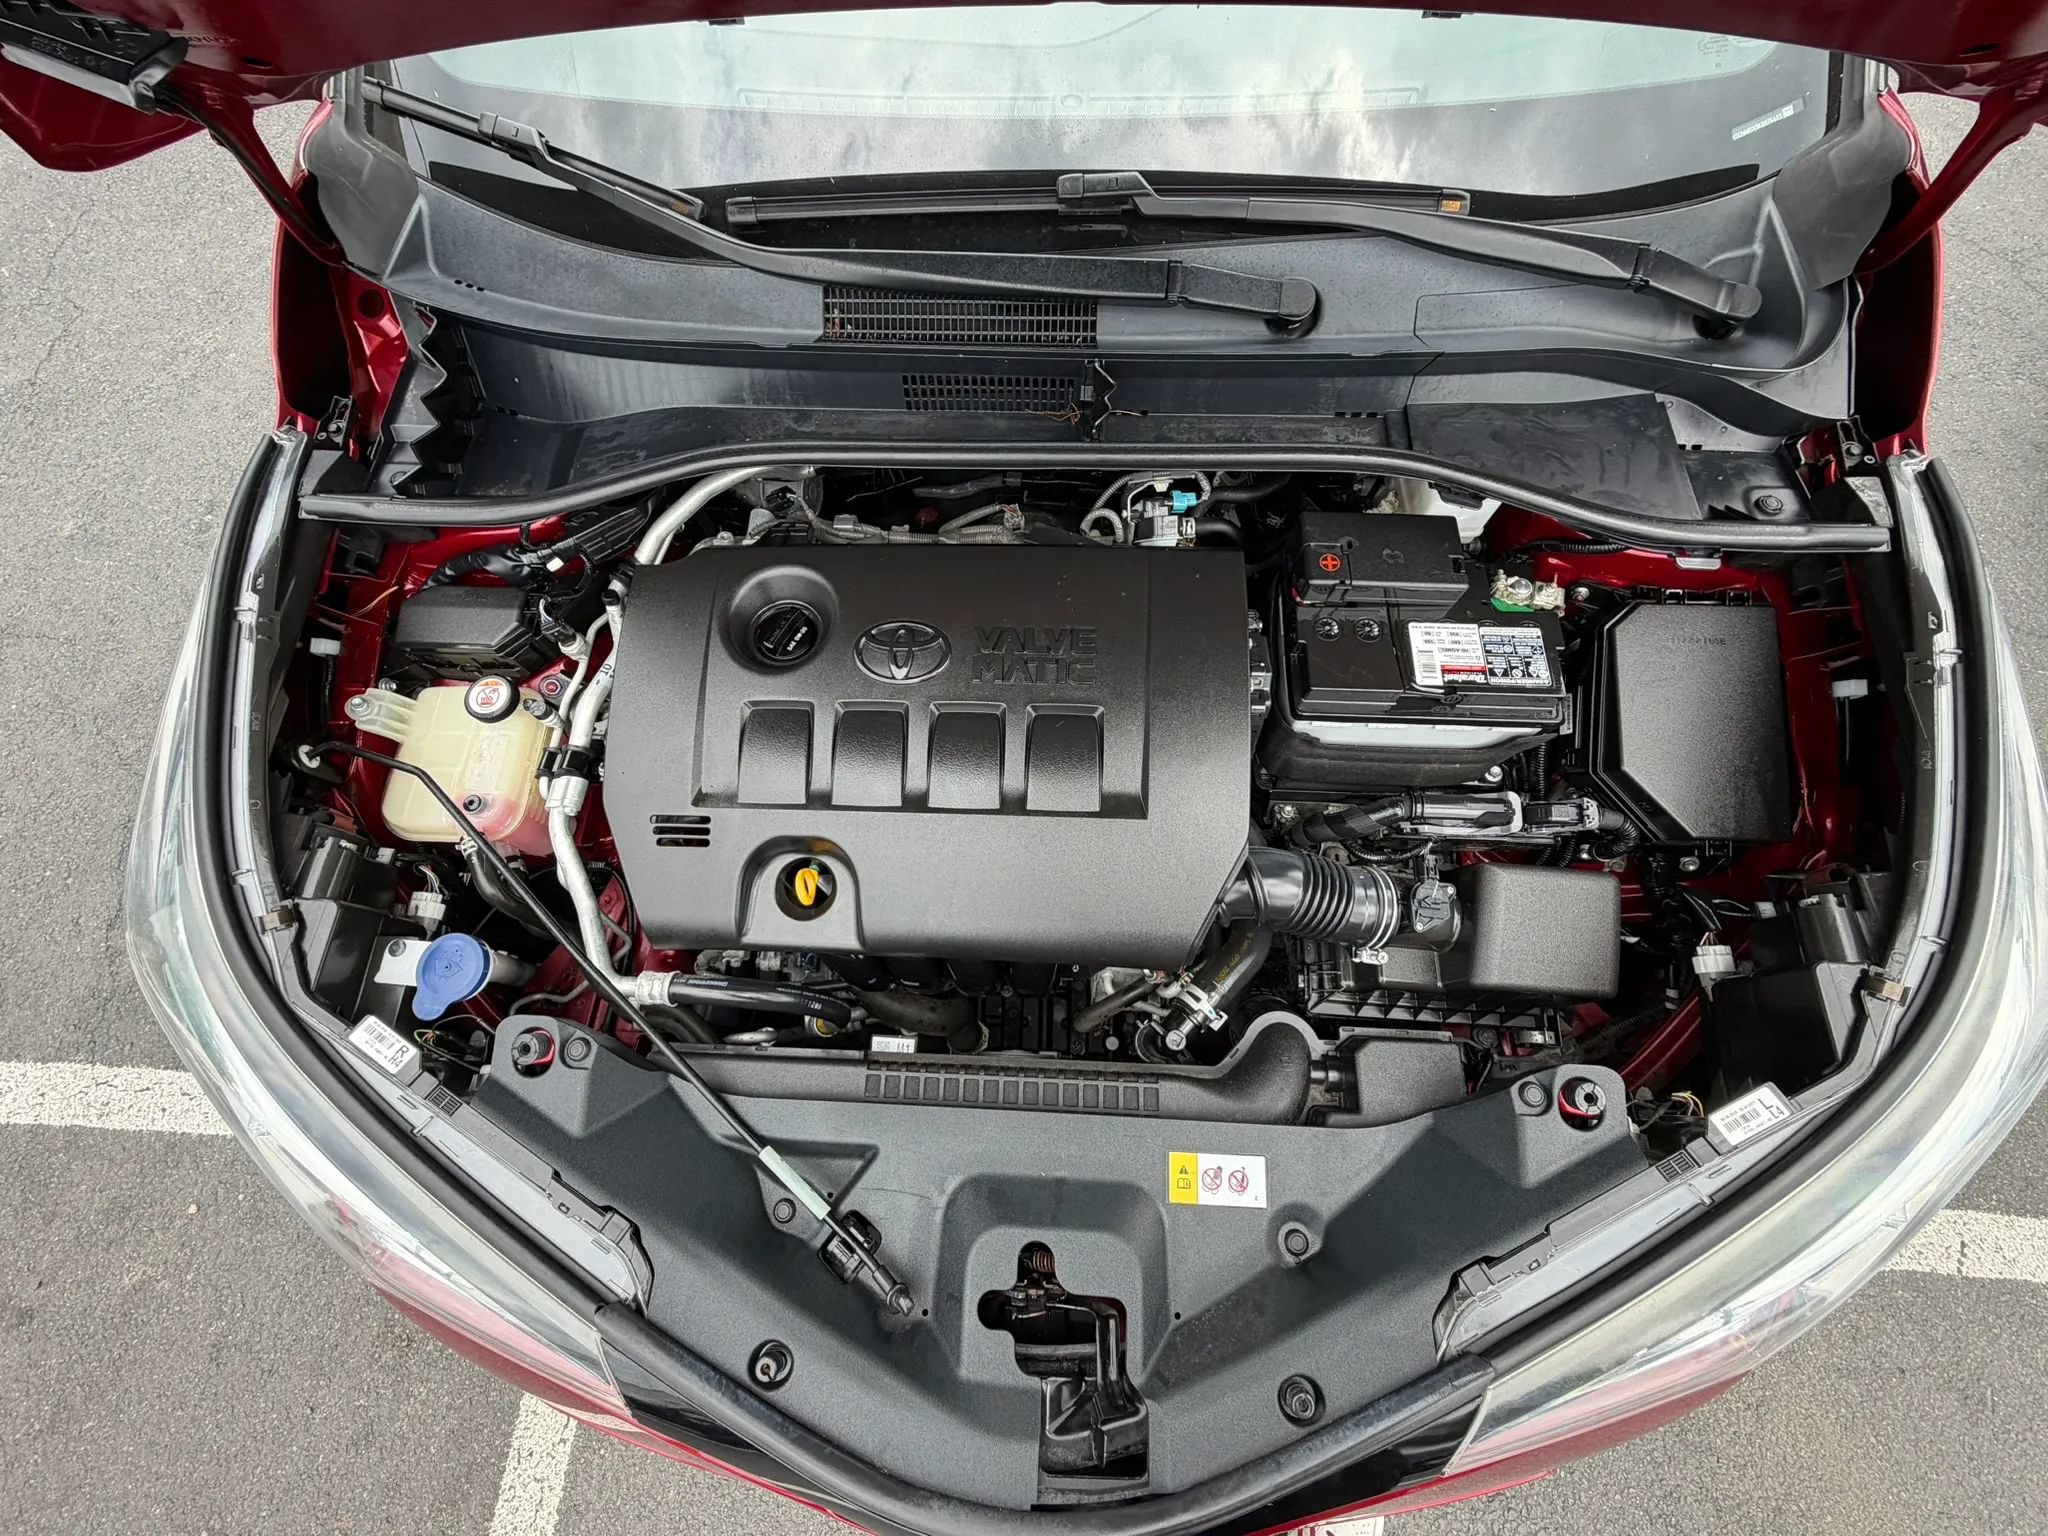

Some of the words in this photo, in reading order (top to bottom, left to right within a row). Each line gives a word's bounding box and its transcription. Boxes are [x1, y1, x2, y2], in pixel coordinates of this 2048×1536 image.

[974, 625, 1096, 656] VALVE
[971, 655, 1096, 686] MATIC
[1443, 673, 1487, 683] Duralast
